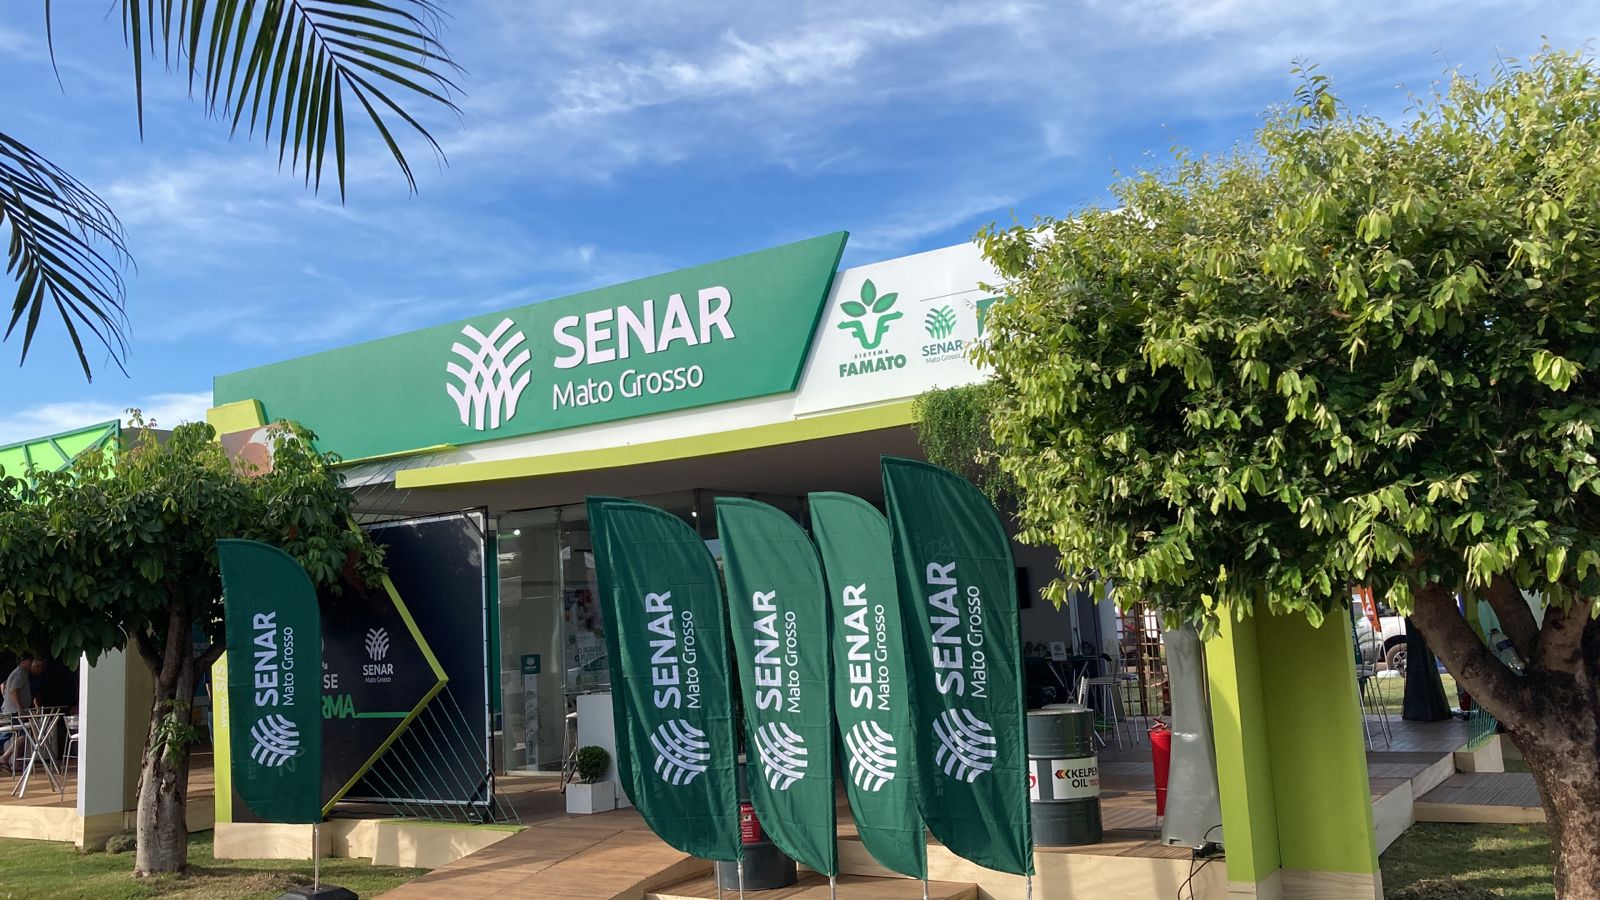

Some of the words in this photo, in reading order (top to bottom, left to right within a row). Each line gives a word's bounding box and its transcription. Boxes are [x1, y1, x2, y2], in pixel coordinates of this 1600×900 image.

[552, 285, 735, 369] SENAR
[922, 339, 963, 356] SENAR
[839, 354, 907, 377] FAMATO
[854, 349, 890, 359] SISTEMA
[925, 356, 940, 364] Mato
[941, 353, 961, 362] Grosso
[552, 379, 613, 410] Mato
[619, 364, 704, 398] Grosso
[681, 610, 697, 664] Grosso
[784, 611, 798, 666] Grosso
[874, 604, 887, 662] Grosso
[926, 561, 965, 697] SENAR
[967, 585, 983, 647] Grosso
[253, 611, 278, 707] SENAR
[282, 626, 294, 670] Grosso
[362, 663, 394, 676] SENAR
[645, 590, 682, 709] SENAR
[752, 590, 783, 712] SENAR
[842, 583, 873, 710] SENAR
[282, 671, 294, 706] Mato
[686, 667, 701, 709] Mato
[787, 670, 801, 713] Mato
[877, 666, 890, 711] Mato
[970, 651, 987, 698] Mato
[1072, 778, 1088, 788] OIL
